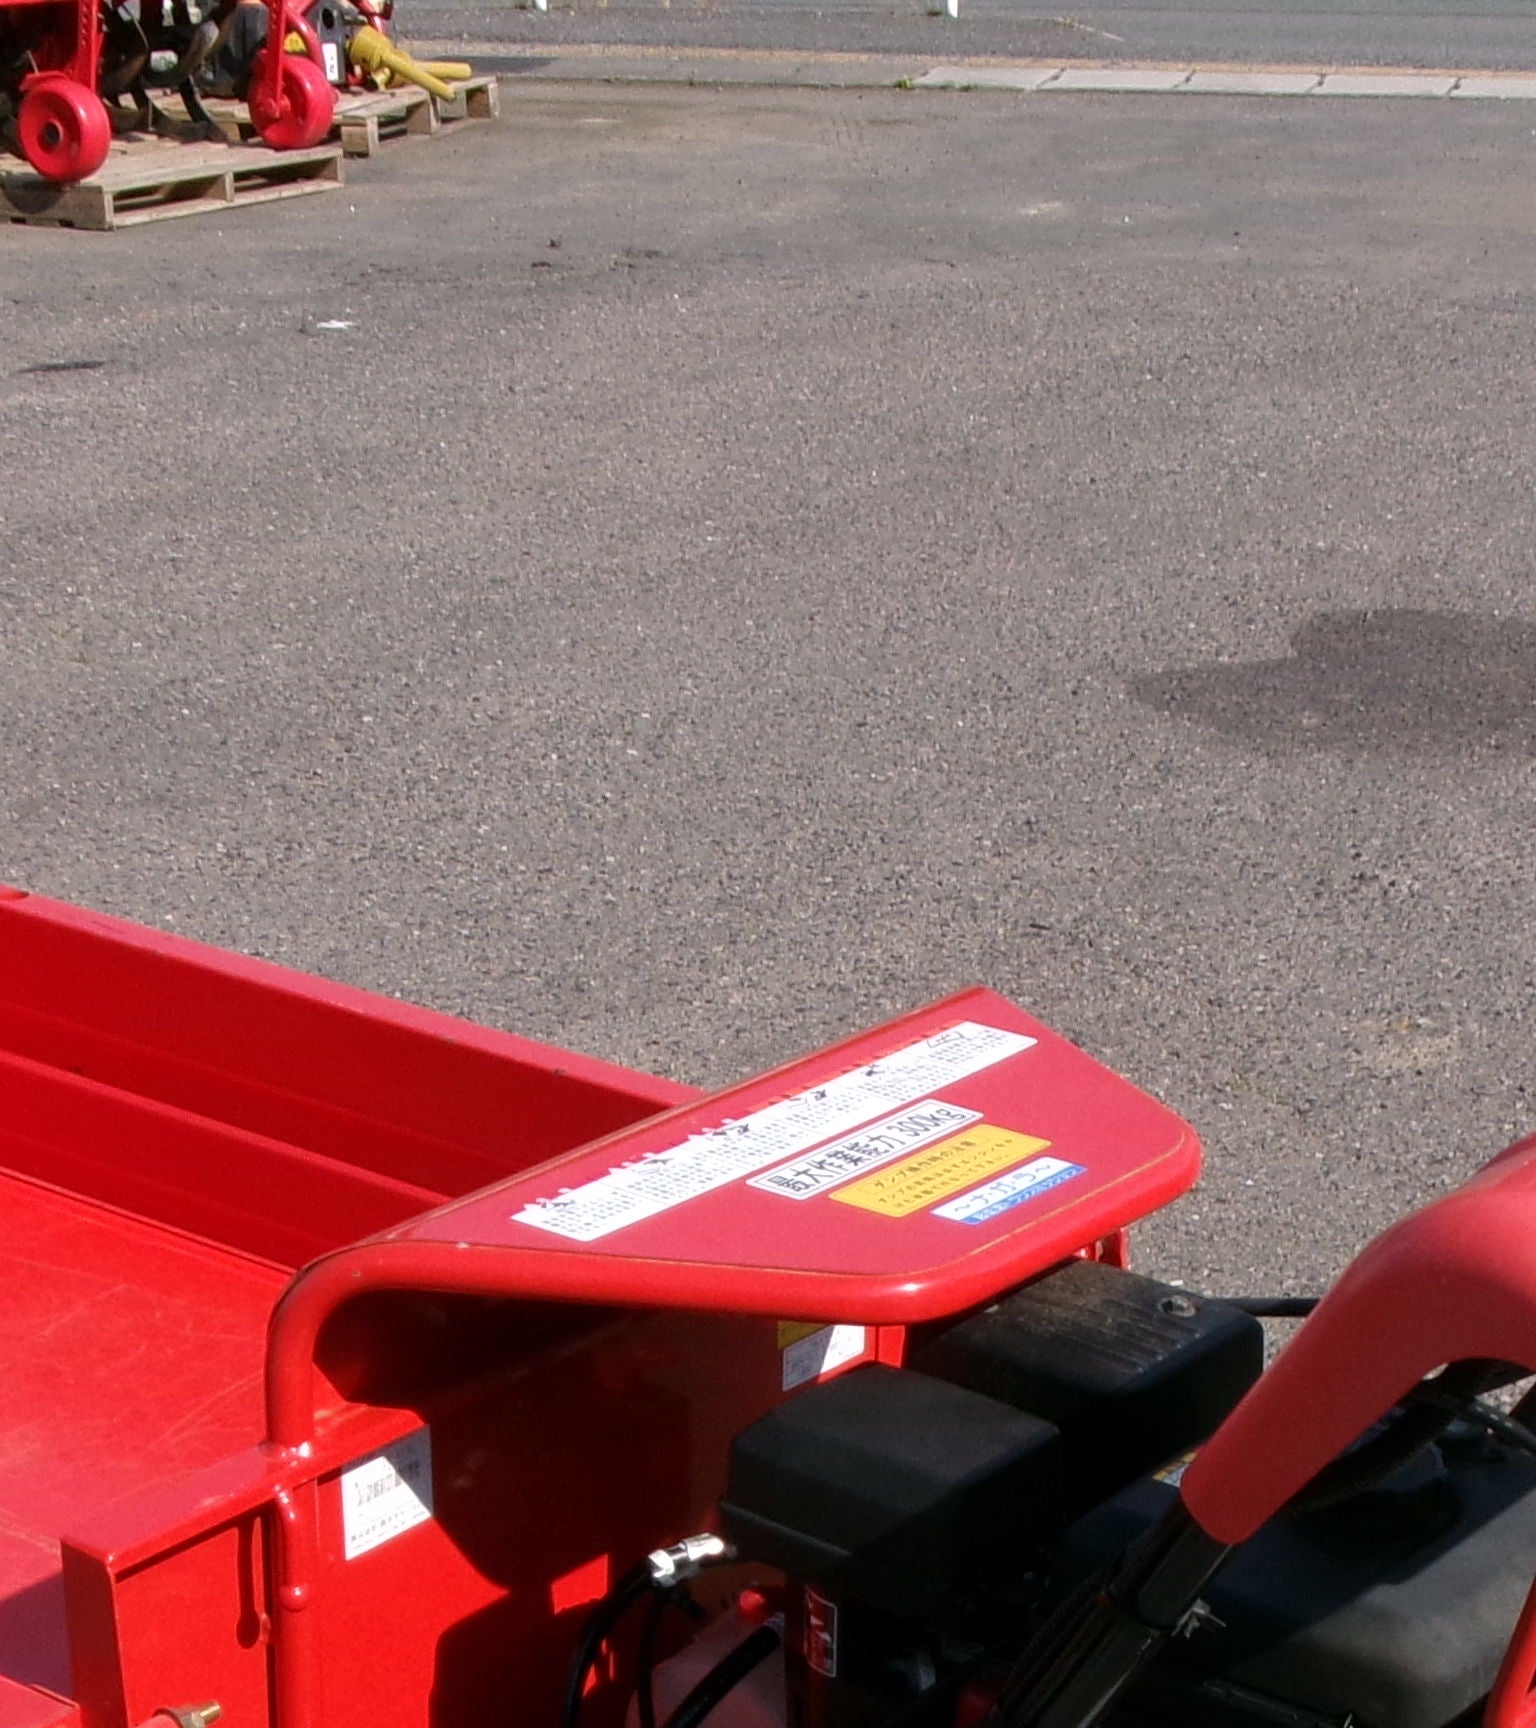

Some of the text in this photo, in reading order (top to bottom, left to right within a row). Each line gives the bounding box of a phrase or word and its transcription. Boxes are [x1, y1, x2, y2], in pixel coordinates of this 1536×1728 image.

[767, 1134, 906, 1192] 最大作業能力
[886, 1107, 967, 1138] 300kg
